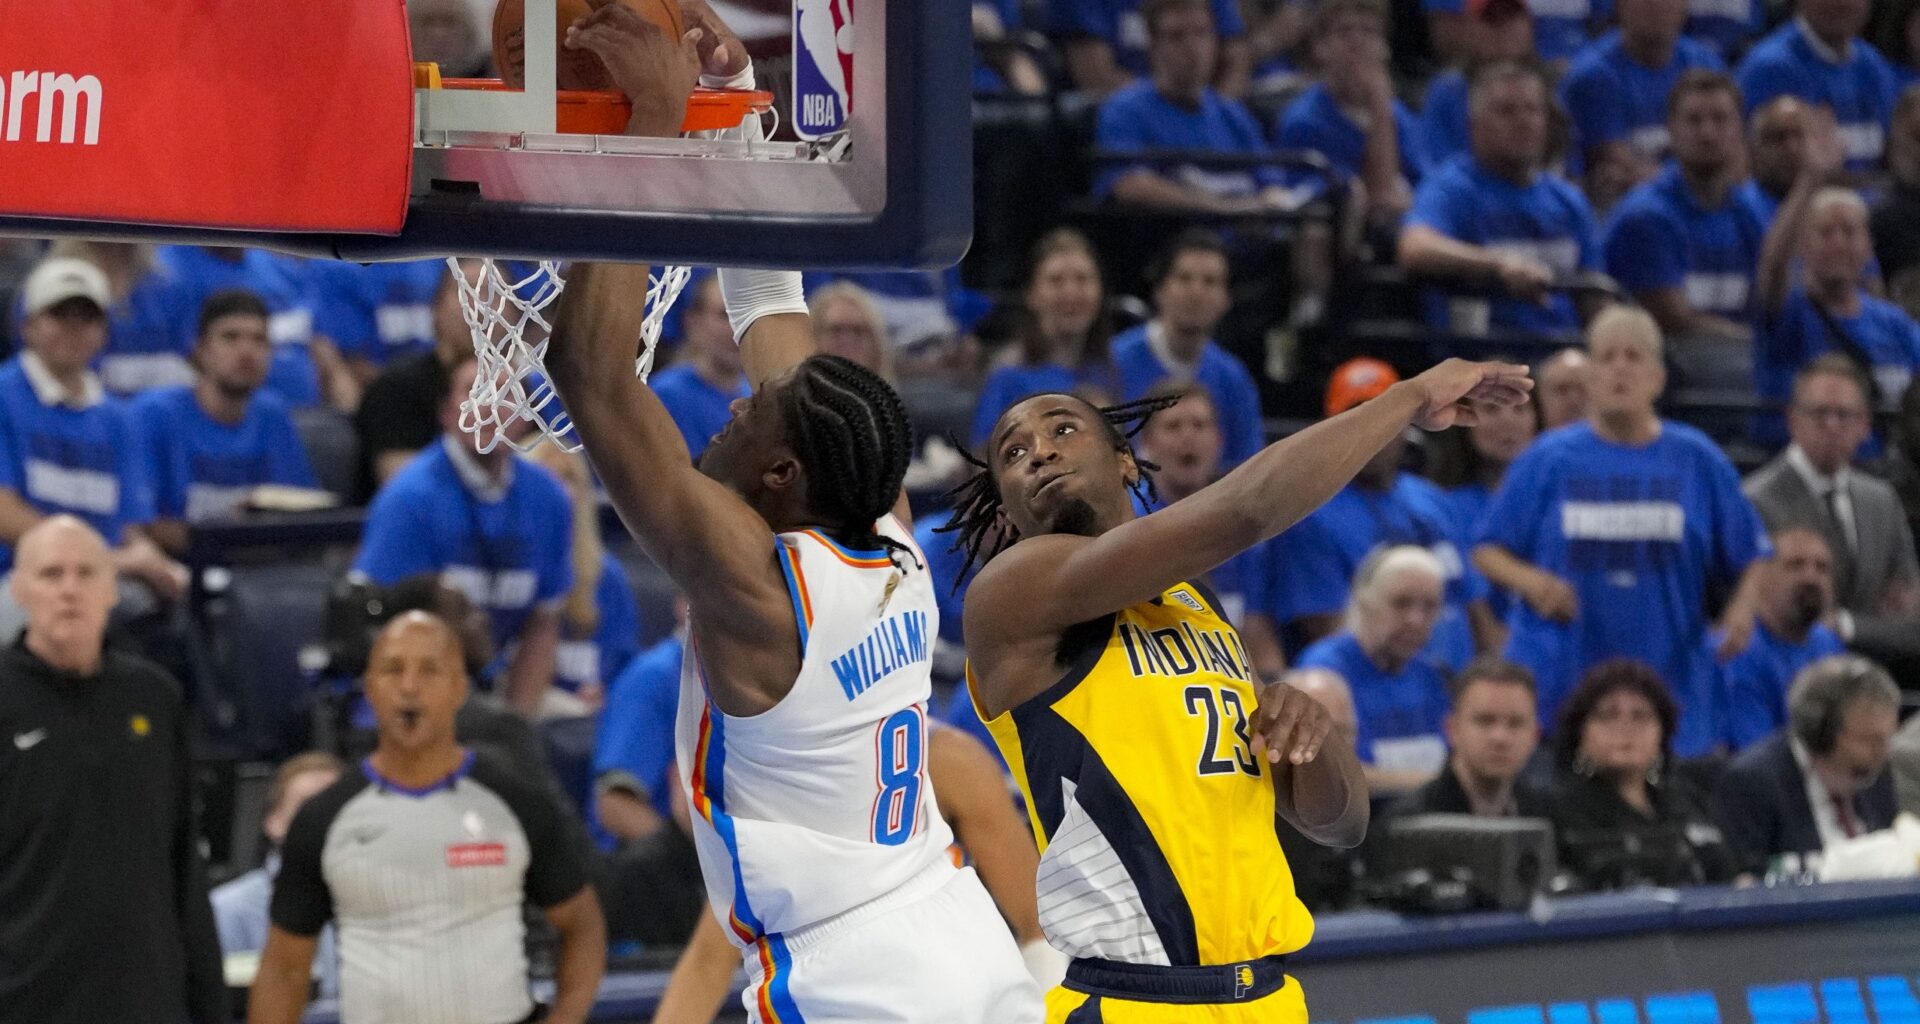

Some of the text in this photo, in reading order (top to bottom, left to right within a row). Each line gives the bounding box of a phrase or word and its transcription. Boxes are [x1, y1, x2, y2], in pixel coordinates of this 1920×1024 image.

[803, 93, 835, 127] NBA
[1118, 621, 1251, 682] INDIANA
[1184, 684, 1262, 778] 23
[870, 703, 924, 847] 8
